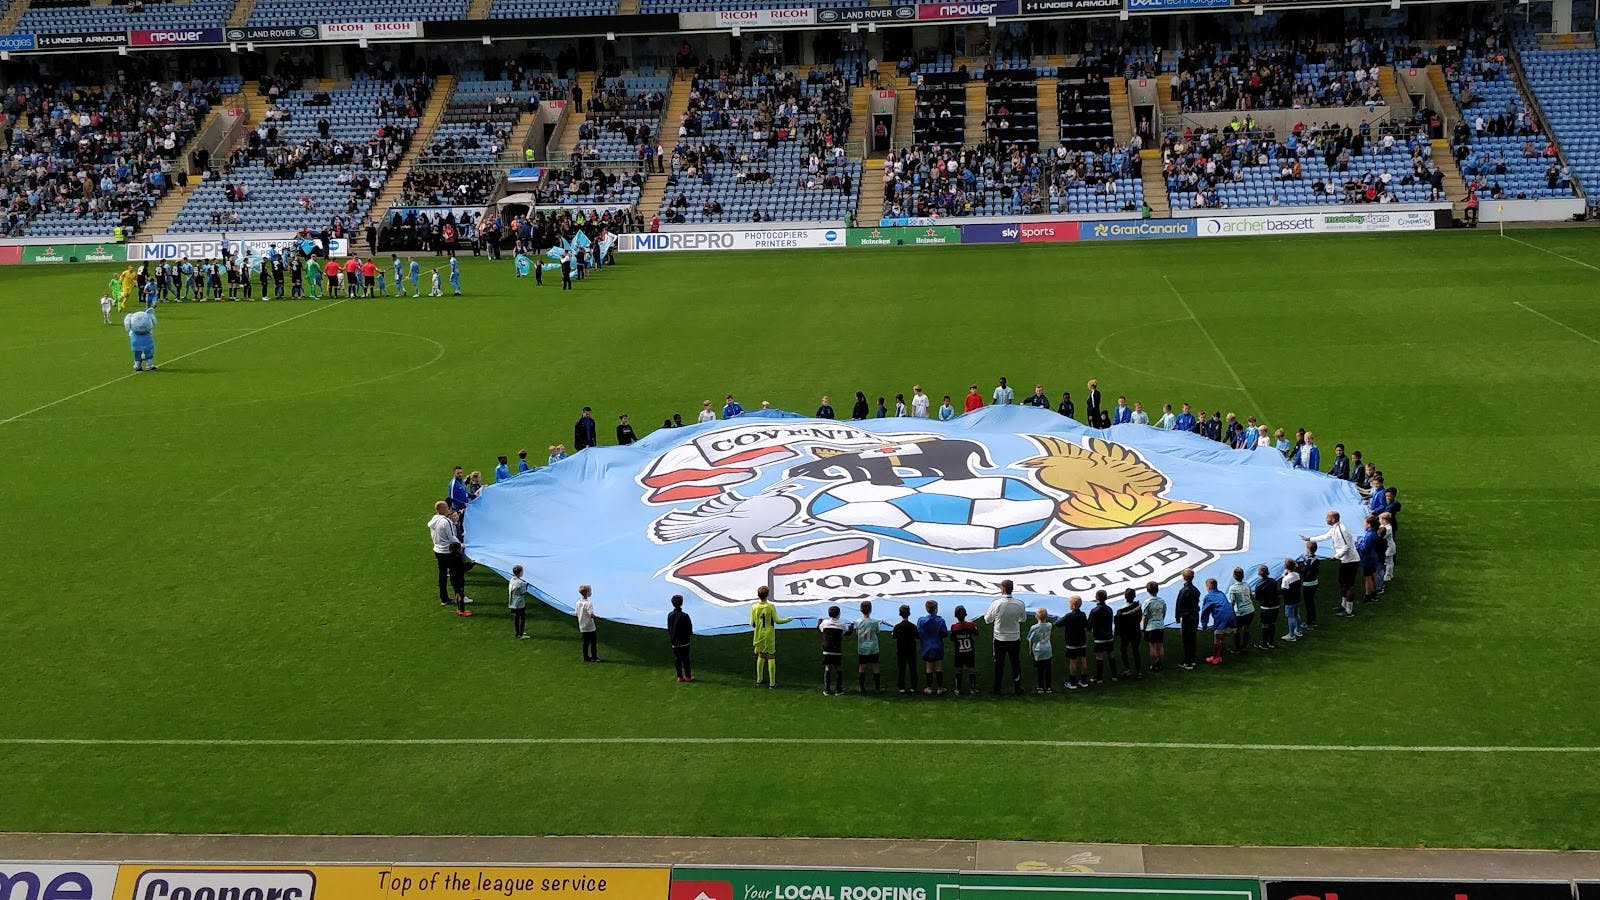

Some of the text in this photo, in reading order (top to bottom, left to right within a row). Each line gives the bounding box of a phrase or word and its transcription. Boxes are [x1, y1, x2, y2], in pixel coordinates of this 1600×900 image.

[720, 11, 758, 20] RICOH
[771, 9, 808, 18] RICOH
[841, 11, 864, 19] LAND
[865, 9, 893, 18] ROVER
[328, 24, 364, 32] RICOH
[374, 22, 410, 31] RICOH
[271, 29, 296, 37] ROVER
[85, 35, 126, 43] ARMOUR
[1110, 222, 1188, 235] GranCanaria
[1223, 217, 1315, 232] archerbassett
[744, 231, 808, 240] PHOTOCOPIERS
[1002, 227, 1055, 239] sky sports
[635, 233, 734, 249] MIDREPRO
[755, 239, 798, 248] PRINTERS
[915, 236, 946, 244] Heineken
[250, 241, 294, 249] PHOTOCOP
[711, 428, 884, 452] COVENT
[1062, 546, 1188, 593] CLUB
[957, 638, 972, 650] 10
[378, 871, 607, 896] Top of the league service
[743, 884, 926, 900] Your LOCAL ROOFING
